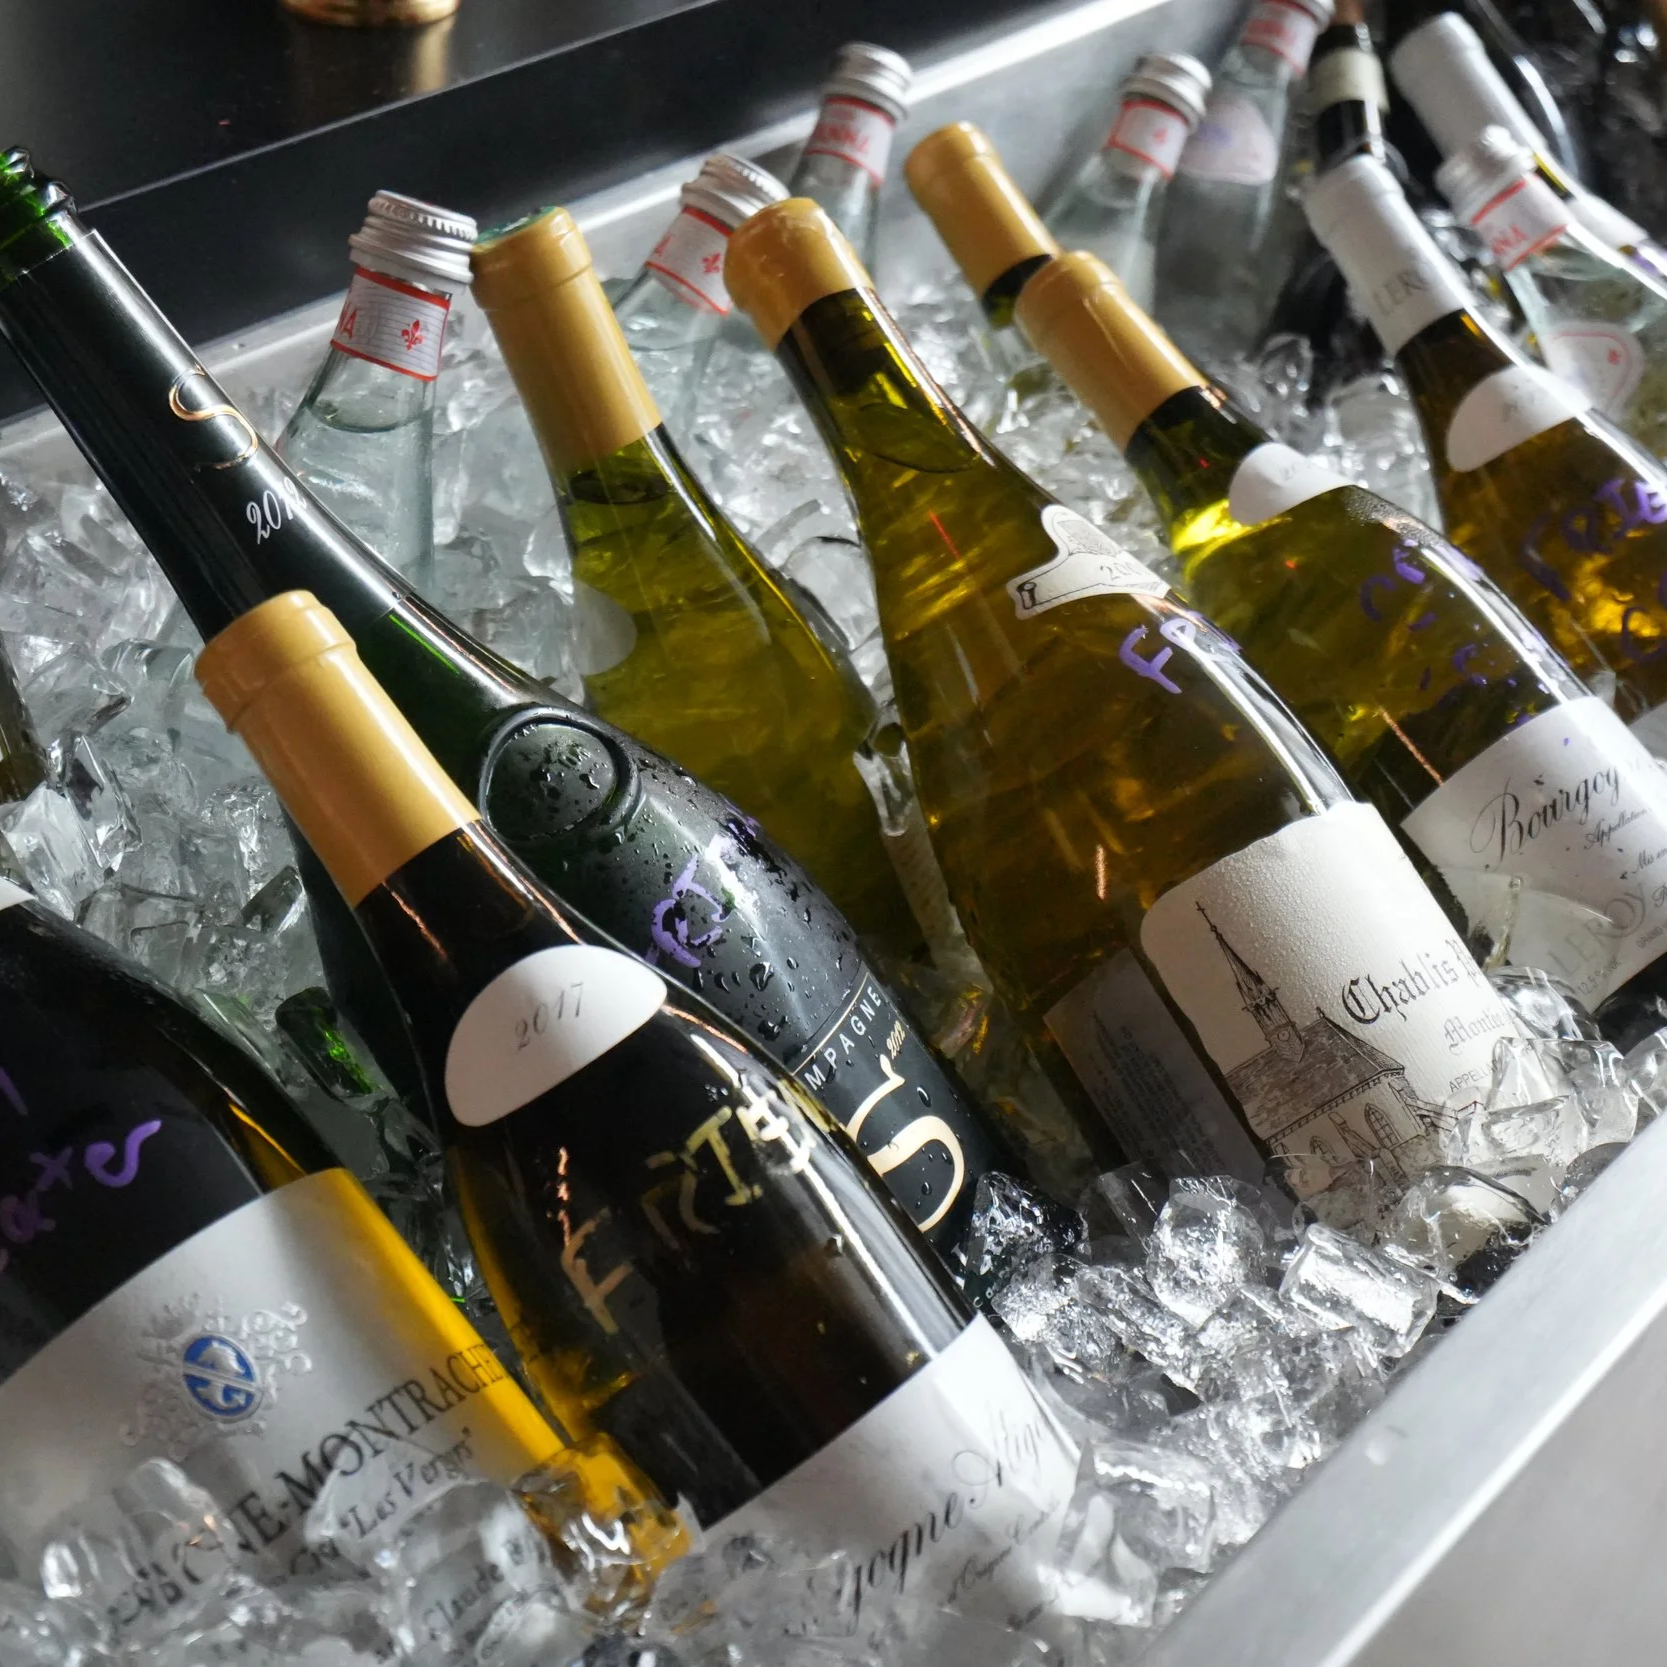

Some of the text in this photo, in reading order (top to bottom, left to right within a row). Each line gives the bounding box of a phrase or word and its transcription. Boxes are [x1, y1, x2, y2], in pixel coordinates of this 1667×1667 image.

[515, 981, 584, 1053] 2017
[1342, 953, 1459, 1025] Chablis
[804, 986, 882, 1092] MPAGNE
